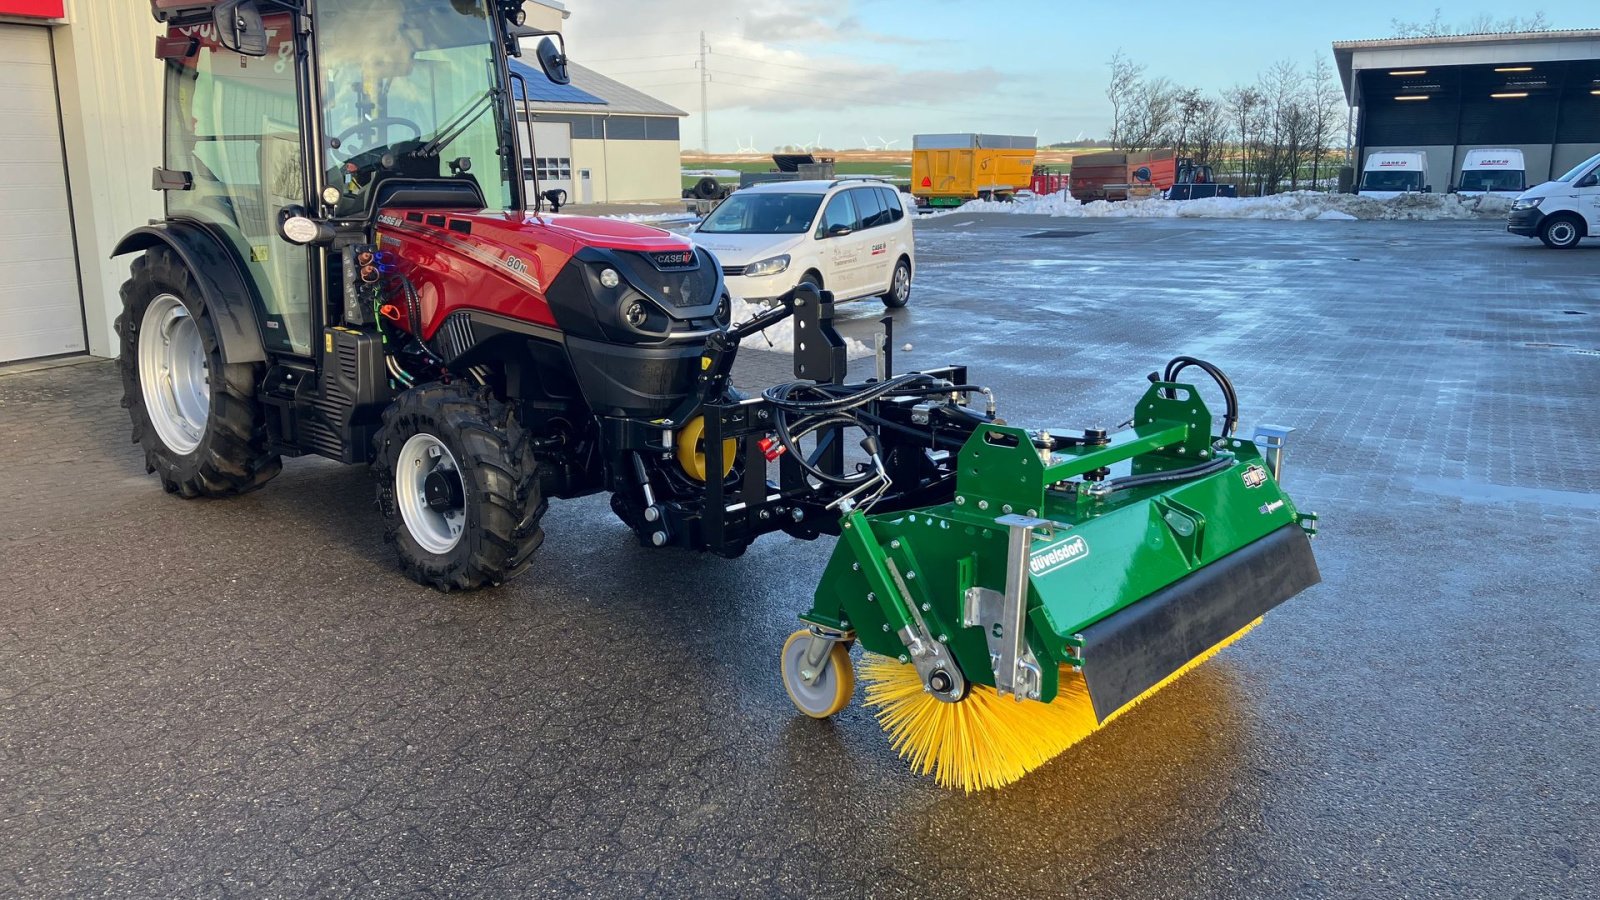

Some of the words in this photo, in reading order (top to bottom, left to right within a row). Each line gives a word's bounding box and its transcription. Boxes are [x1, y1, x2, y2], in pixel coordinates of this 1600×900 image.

[377, 214, 396, 226] CASE
[657, 254, 682, 263] CASE
[1029, 538, 1084, 573] düvelsdorf
